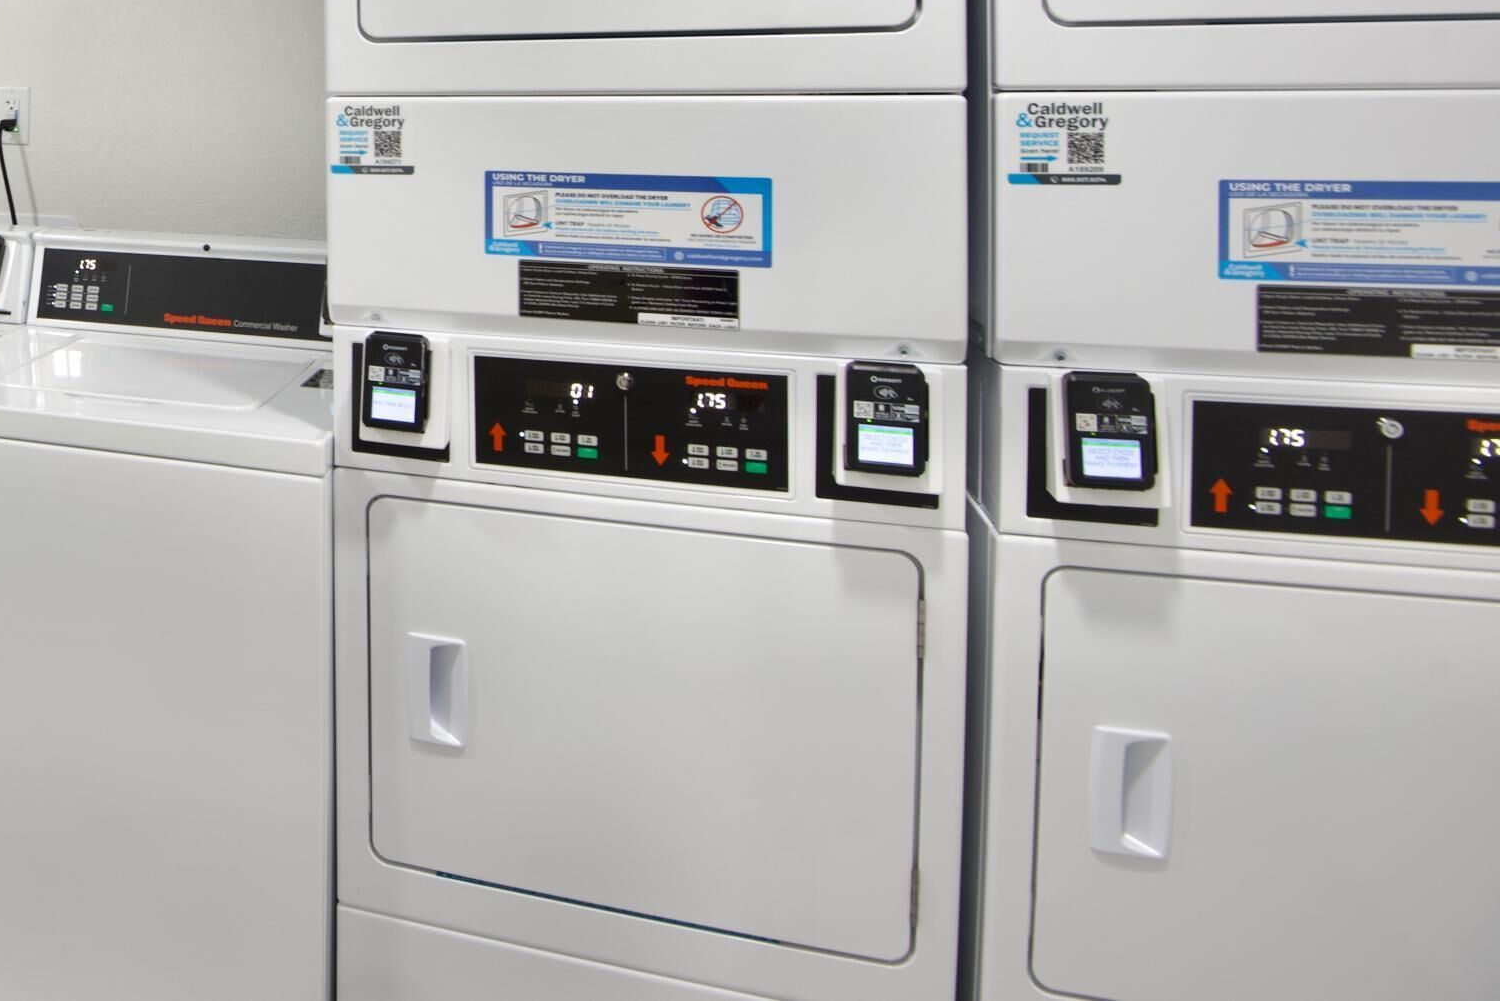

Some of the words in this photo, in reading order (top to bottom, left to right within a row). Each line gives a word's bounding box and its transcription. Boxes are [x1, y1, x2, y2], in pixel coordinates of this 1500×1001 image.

[344, 105, 400, 116] Caldwell
[1027, 102, 1103, 115] Caldwell
[492, 173, 525, 181] USING
[526, 174, 547, 182] THE
[549, 174, 586, 183] DRYER
[1228, 182, 1271, 192] USING
[1273, 183, 1301, 192] THE
[1304, 183, 1352, 193] DRYER
[164, 313, 196, 324] Speed
[197, 314, 231, 327] Queen
[233, 319, 272, 330] Commercial
[273, 323, 299, 332] Washer
[685, 376, 725, 387] Speed
[726, 378, 768, 390] Queen
